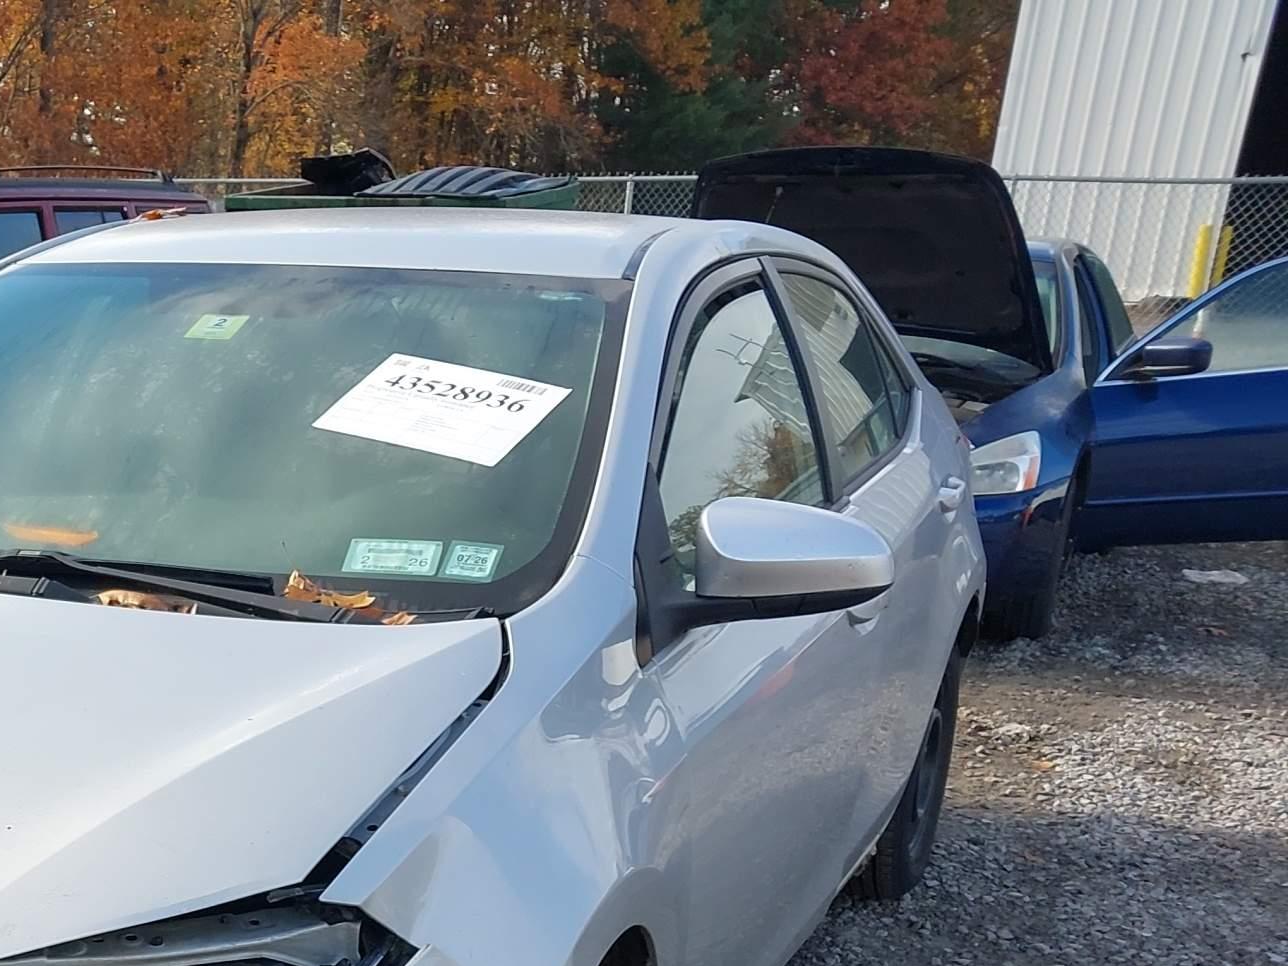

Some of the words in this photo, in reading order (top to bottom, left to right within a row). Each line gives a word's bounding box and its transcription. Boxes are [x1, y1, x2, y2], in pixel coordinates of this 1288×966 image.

[213, 318, 228, 327] 2
[384, 374, 531, 414] 43528936
[407, 557, 429, 568] 26
